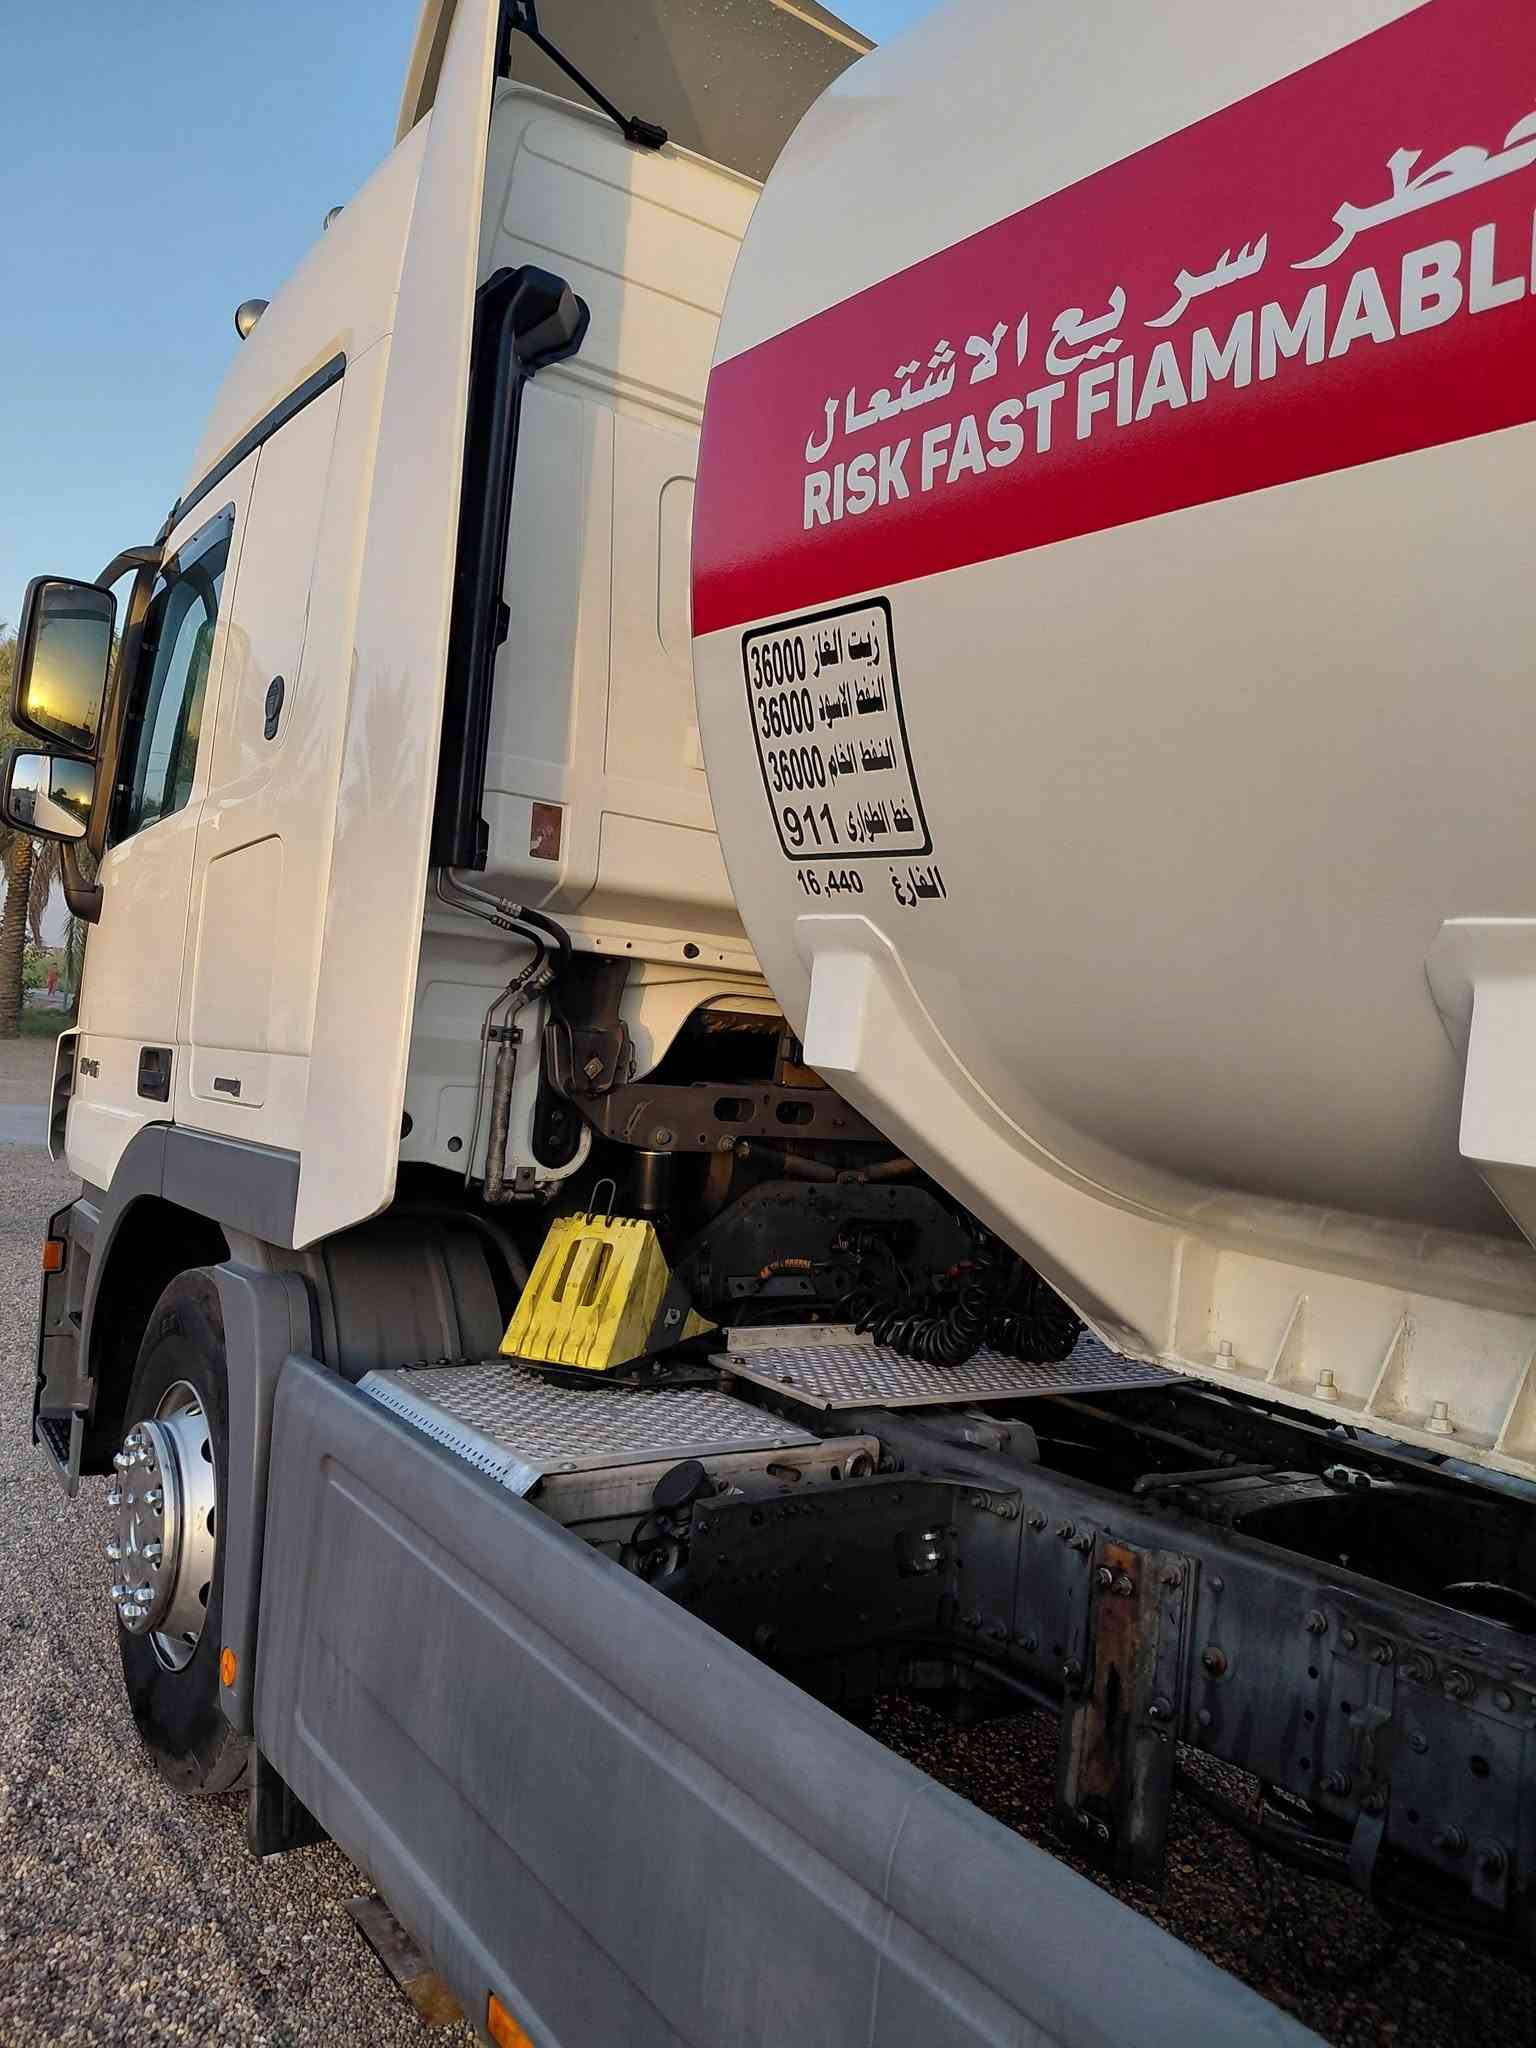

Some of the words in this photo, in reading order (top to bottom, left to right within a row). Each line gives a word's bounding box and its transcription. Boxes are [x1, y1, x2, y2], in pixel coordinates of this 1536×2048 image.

[803, 438, 912, 530] RISK
[921, 380, 1065, 491] FAST
[1076, 207, 1536, 440] FIAMMABL
[805, 311, 1029, 464] الاشتعال
[751, 636, 807, 690] 36000
[847, 620, 880, 667] زيت
[758, 687, 815, 739] 36000
[855, 674, 888, 715] النفط
[767, 745, 826, 792] 36000
[827, 744, 858, 788] الخام
[860, 736, 897, 772] النفط
[783, 803, 839, 846] 911
[890, 798, 914, 832] خط
[797, 868, 864, 898] 16,440
[888, 865, 947, 907] الفارغ
